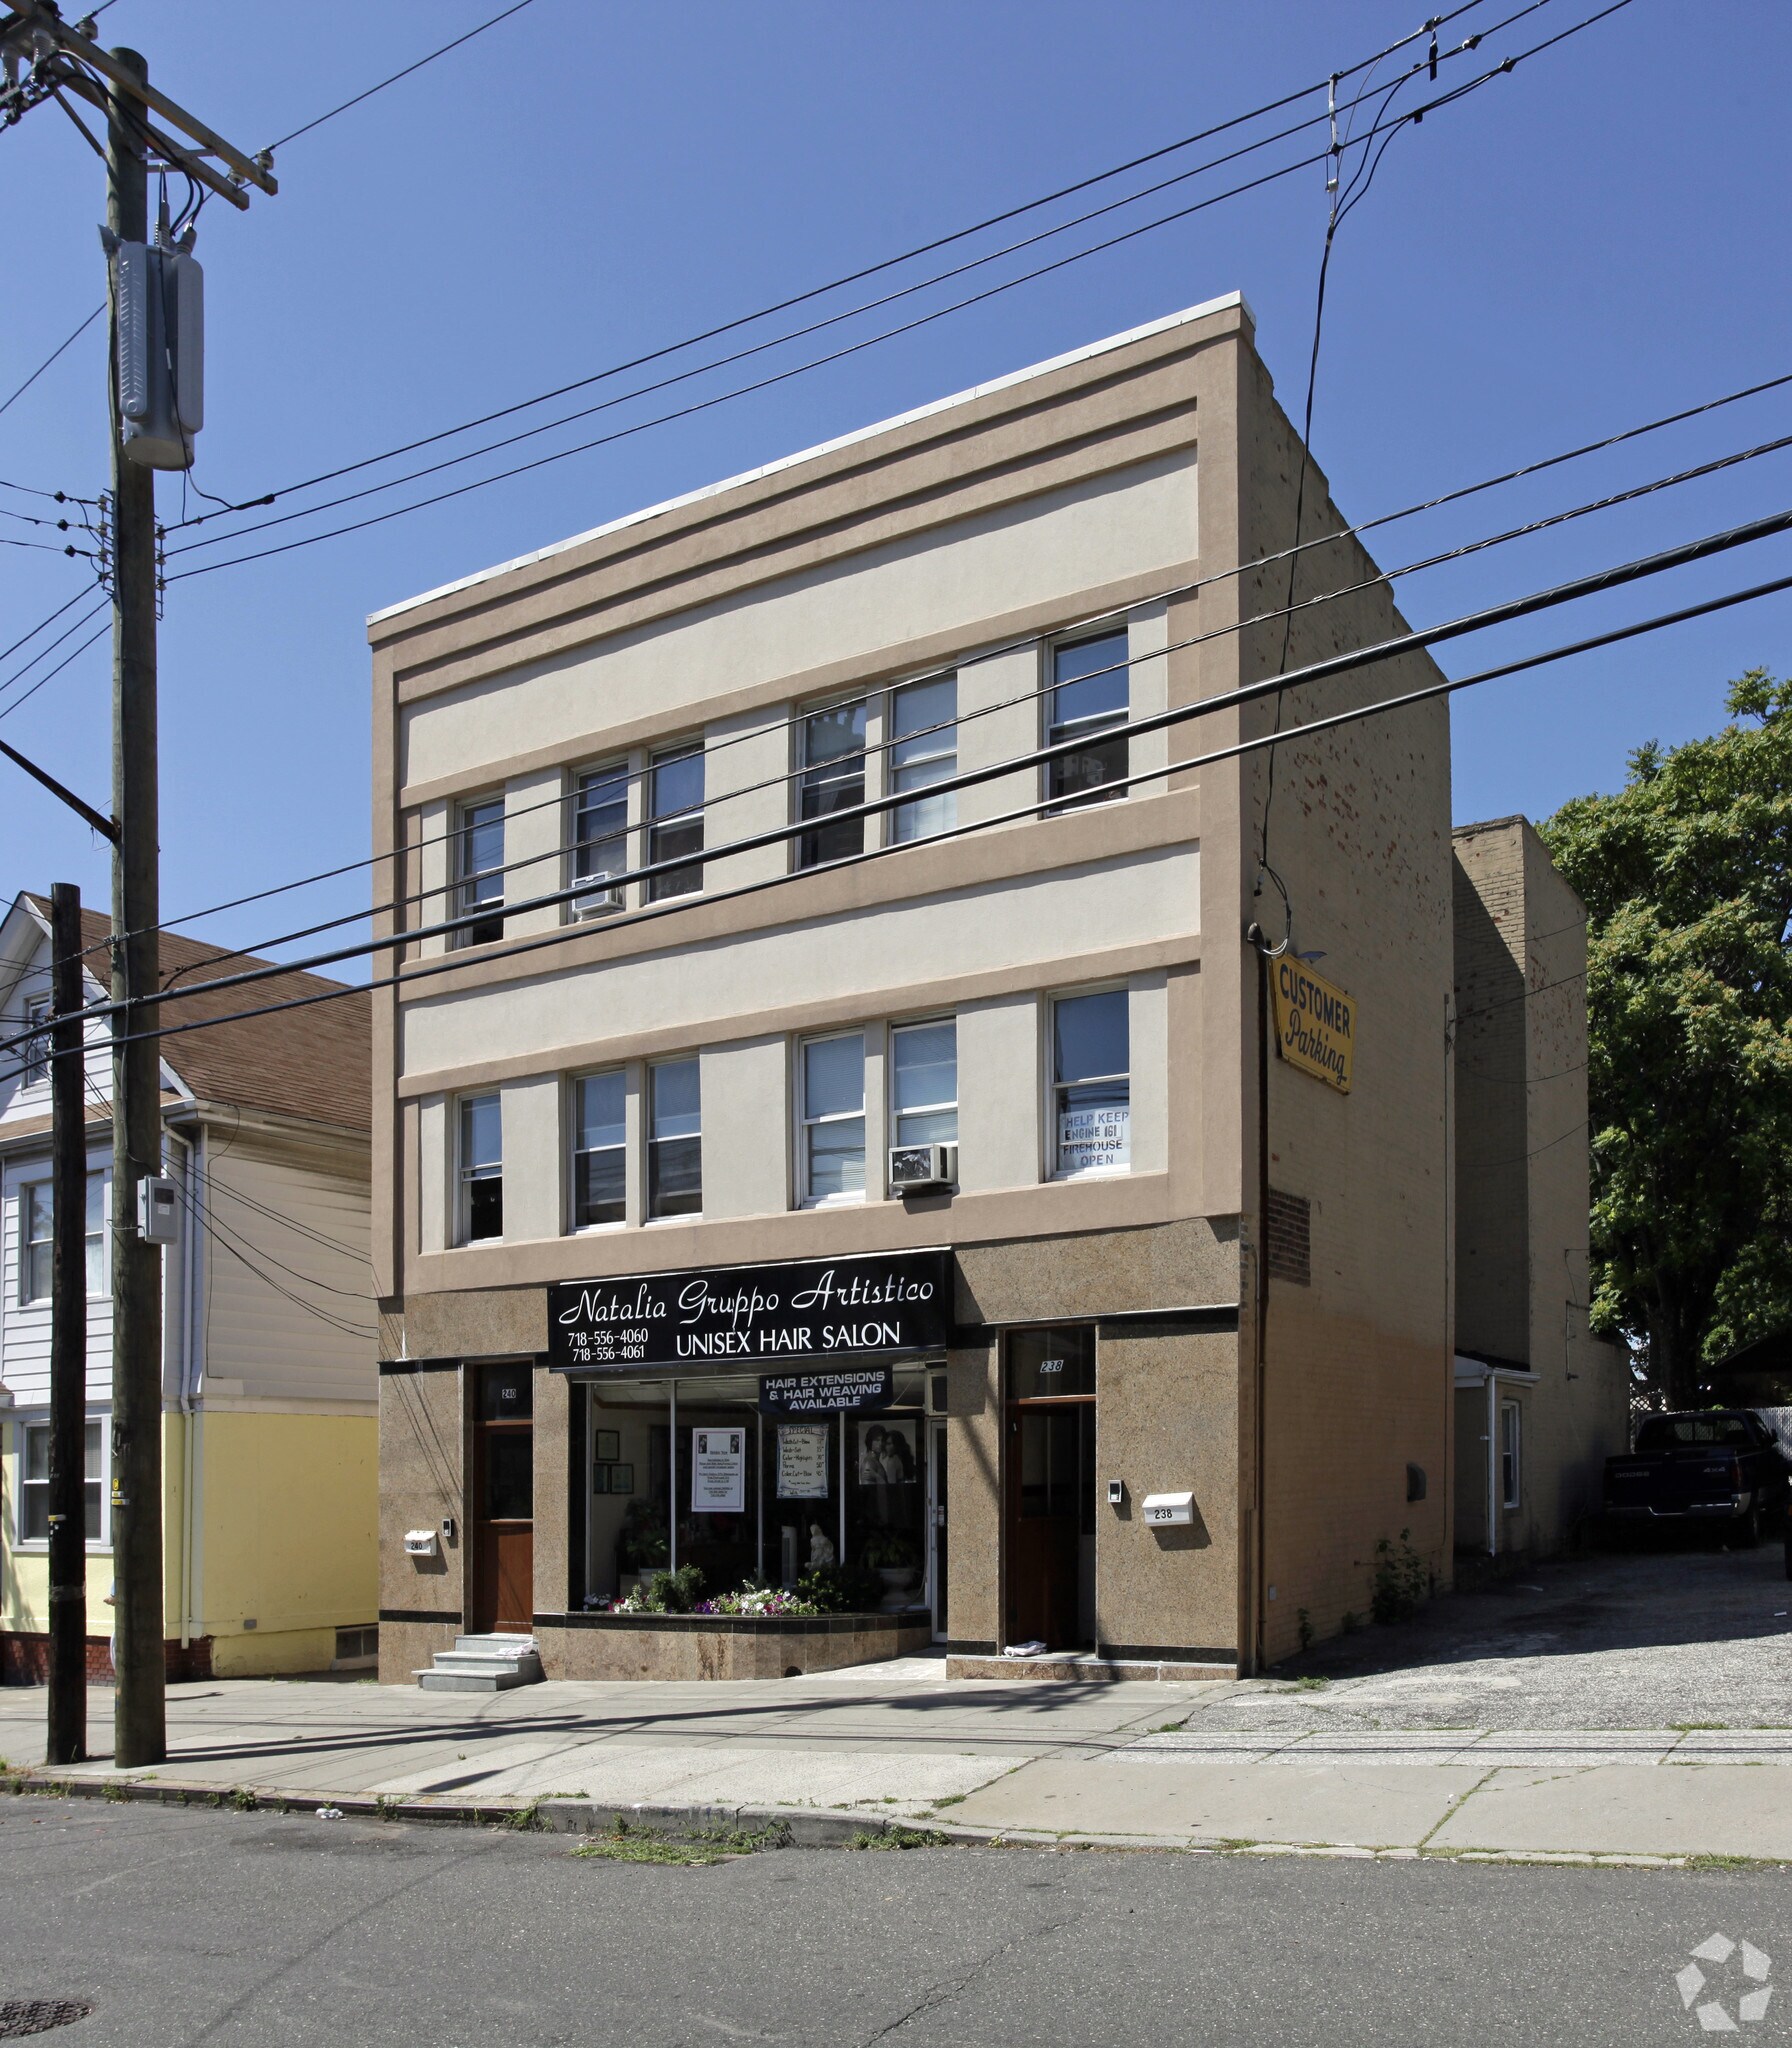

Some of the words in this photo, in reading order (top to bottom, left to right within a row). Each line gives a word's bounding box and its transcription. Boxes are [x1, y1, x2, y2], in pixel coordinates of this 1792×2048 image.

[1280, 963, 1350, 1038] CUSTOMER
[1285, 1009, 1347, 1085] Parking
[1067, 1114, 1093, 1128] HELP
[1098, 1112, 1129, 1124] KEEP
[1065, 1126, 1100, 1140] ENGINE
[1104, 1125, 1117, 1137] 161
[1063, 1139, 1123, 1155] FIREHOUSE
[1081, 1154, 1114, 1167] OPEN
[559, 1283, 667, 1324] Natalia
[678, 1280, 779, 1328] Gruppo
[791, 1269, 934, 1310] Artistico
[568, 1328, 649, 1346] 718-556-4060
[676, 1330, 751, 1356] UNISEX
[760, 1327, 812, 1351] HAIR
[822, 1321, 900, 1348] SALON
[573, 1345, 645, 1361] 718-556-4061
[1041, 1360, 1062, 1372] 238
[766, 1378, 797, 1389] HAIR
[801, 1371, 885, 1387] EXTENSIONS
[769, 1391, 779, 1400] &
[784, 1388, 815, 1400] HAIR
[819, 1383, 882, 1397] WEAVING
[789, 1396, 861, 1410] AVAILABLE
[1154, 1508, 1173, 1519] 238
[411, 1542, 423, 1550] 240
